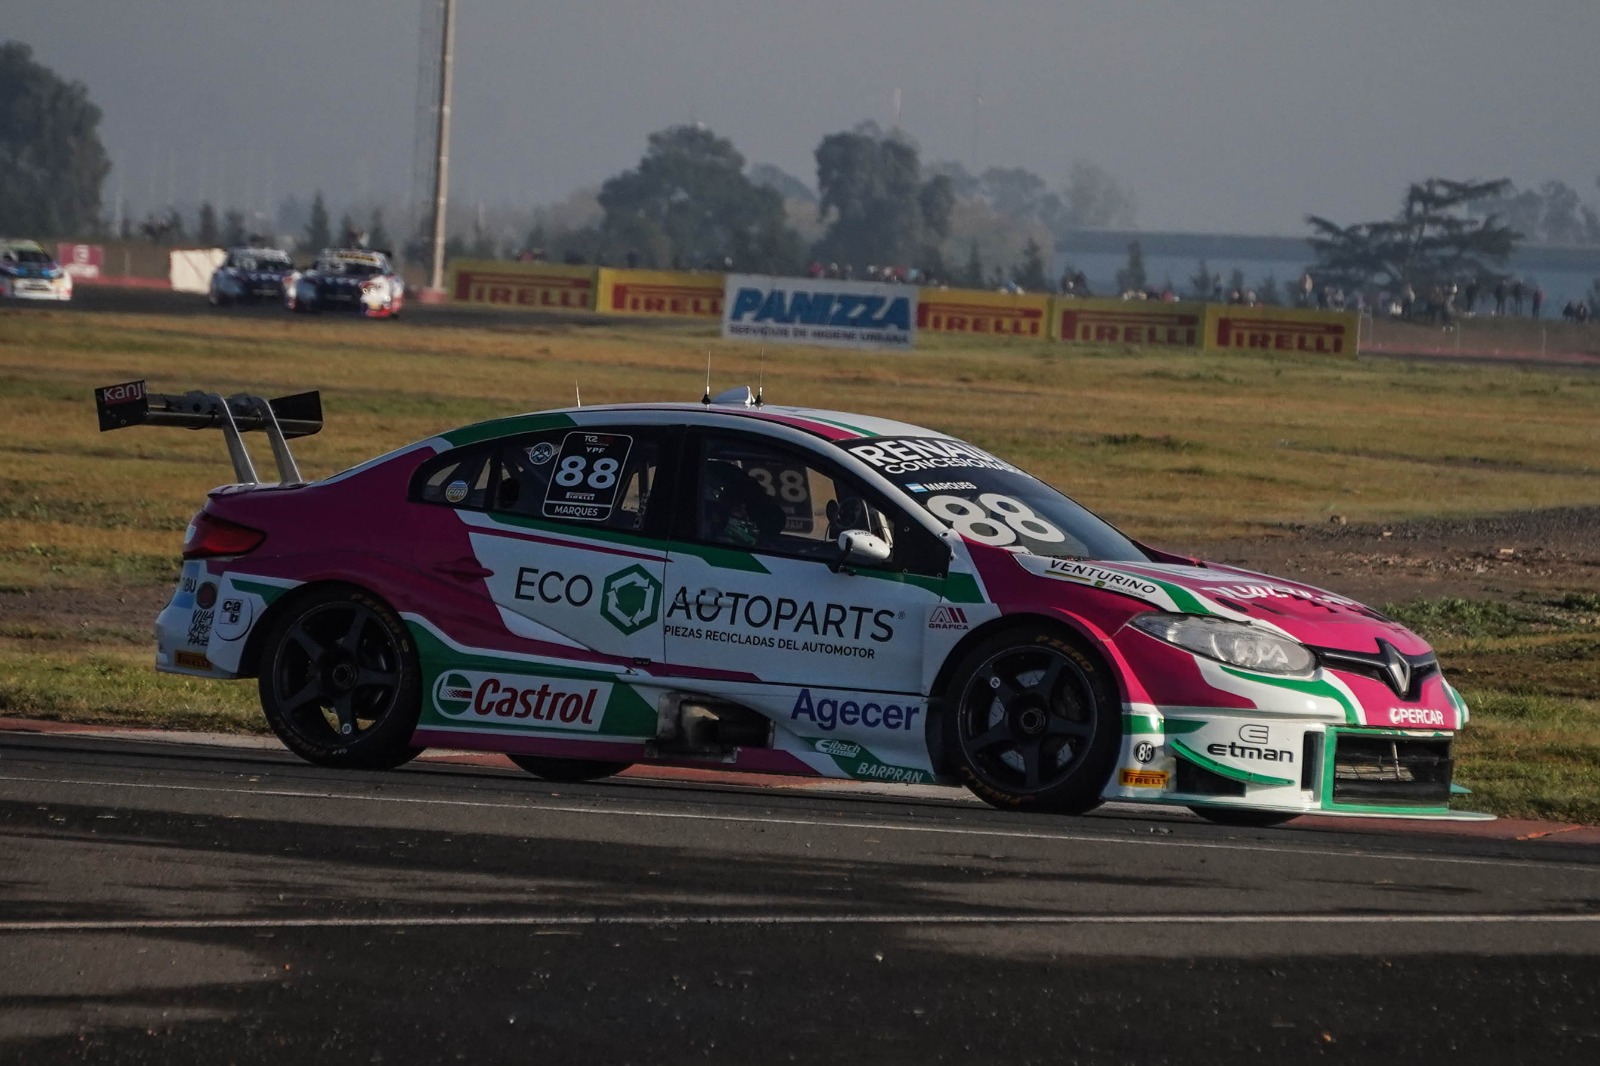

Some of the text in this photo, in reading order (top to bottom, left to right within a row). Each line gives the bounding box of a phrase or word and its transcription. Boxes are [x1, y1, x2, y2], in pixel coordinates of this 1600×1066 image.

[456, 272, 592, 307] PIRELLI
[612, 284, 723, 316] PIRELL
[731, 287, 911, 330] PANIZZA
[917, 302, 1043, 336] PIRELLI
[1061, 310, 1199, 346] PIRELLI
[1217, 318, 1345, 353] PIRELLI
[848, 439, 1003, 467] RENAU
[556, 456, 619, 490] 88
[923, 481, 978, 491] MARQUES
[554, 505, 599, 517] MARQUES
[927, 493, 1066, 546] 88
[1050, 560, 1157, 594] VENTURINO
[514, 567, 896, 643] ECO AUTOPARTS
[664, 625, 876, 660] PIEZAS RECICLADAS DEL AUTOMOTOR
[474, 678, 598, 725] Castrol
[791, 689, 920, 731] Agecer
[815, 740, 861, 754] Eibach
[1138, 743, 1153, 762] 88
[1207, 742, 1294, 763] etman
[857, 762, 923, 783] BARPRAN
